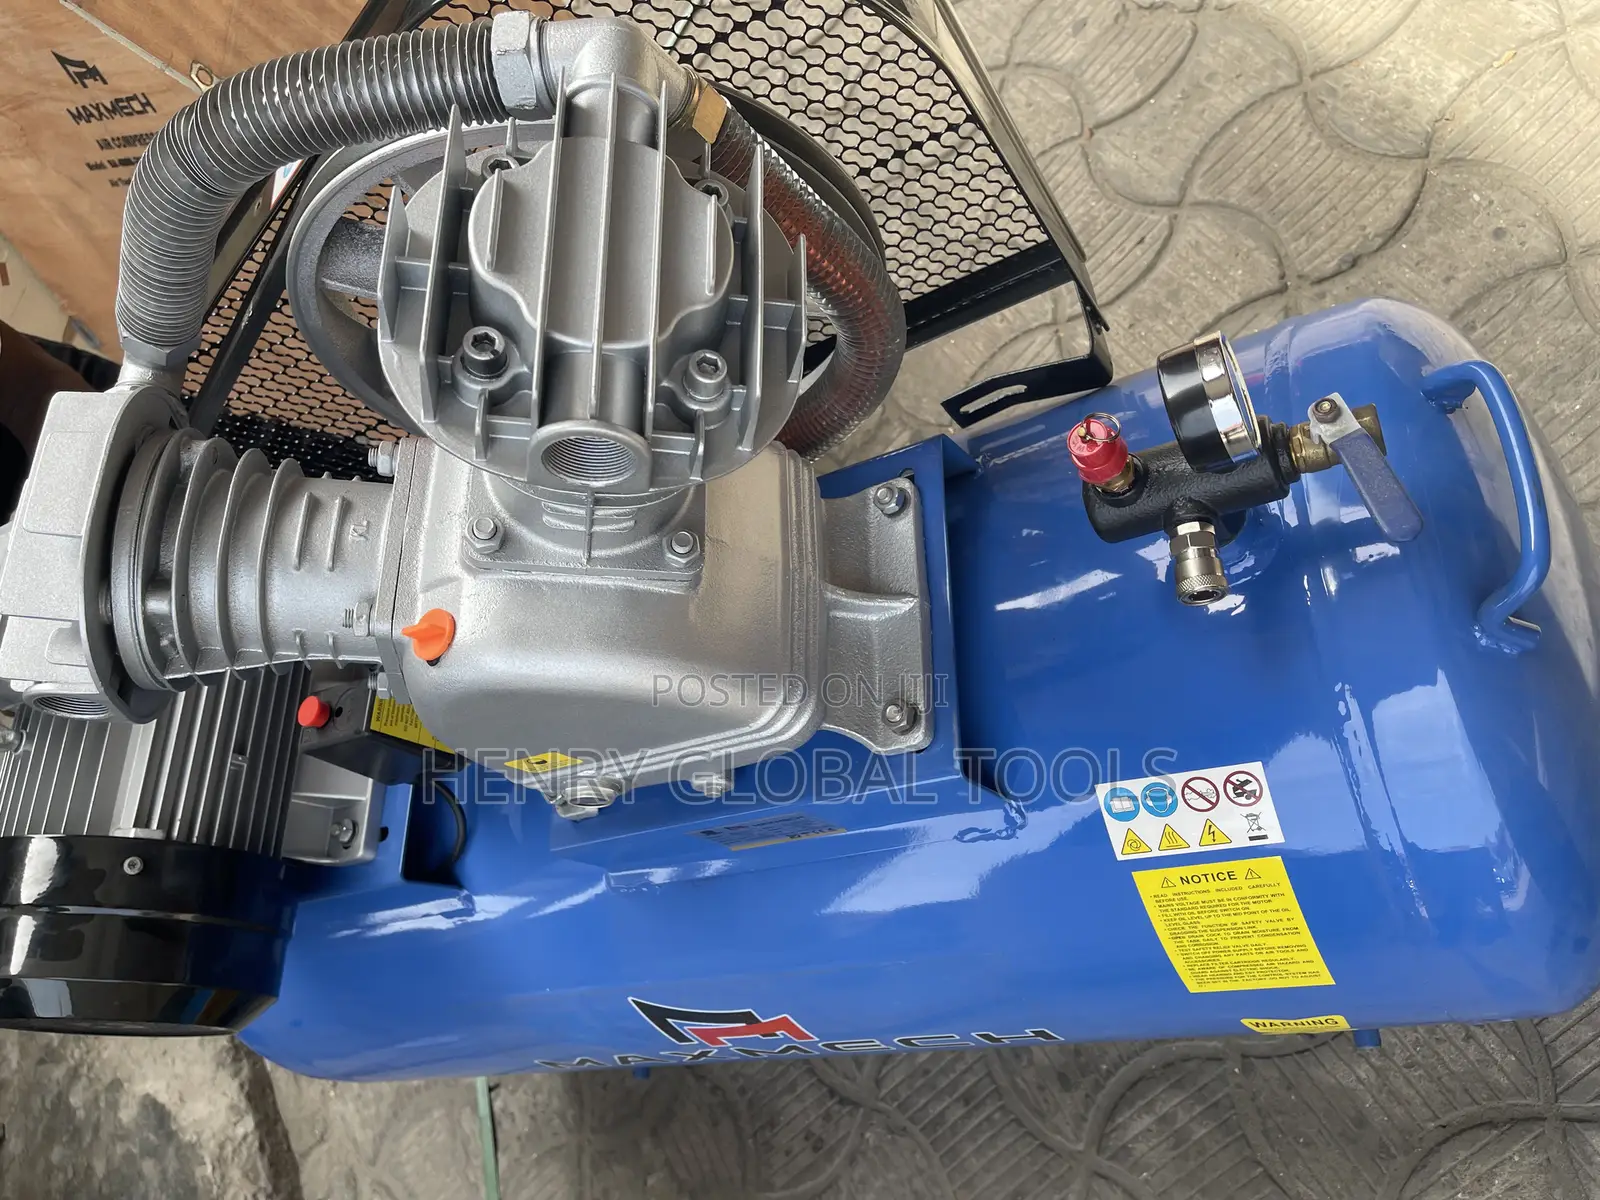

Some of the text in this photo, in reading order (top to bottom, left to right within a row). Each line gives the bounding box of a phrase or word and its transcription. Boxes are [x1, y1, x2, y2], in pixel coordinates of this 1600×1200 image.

[66, 92, 157, 126] MAXMECH
[1180, 871, 1238, 885] NOTICE
[1249, 1017, 1339, 1029] WARNING
